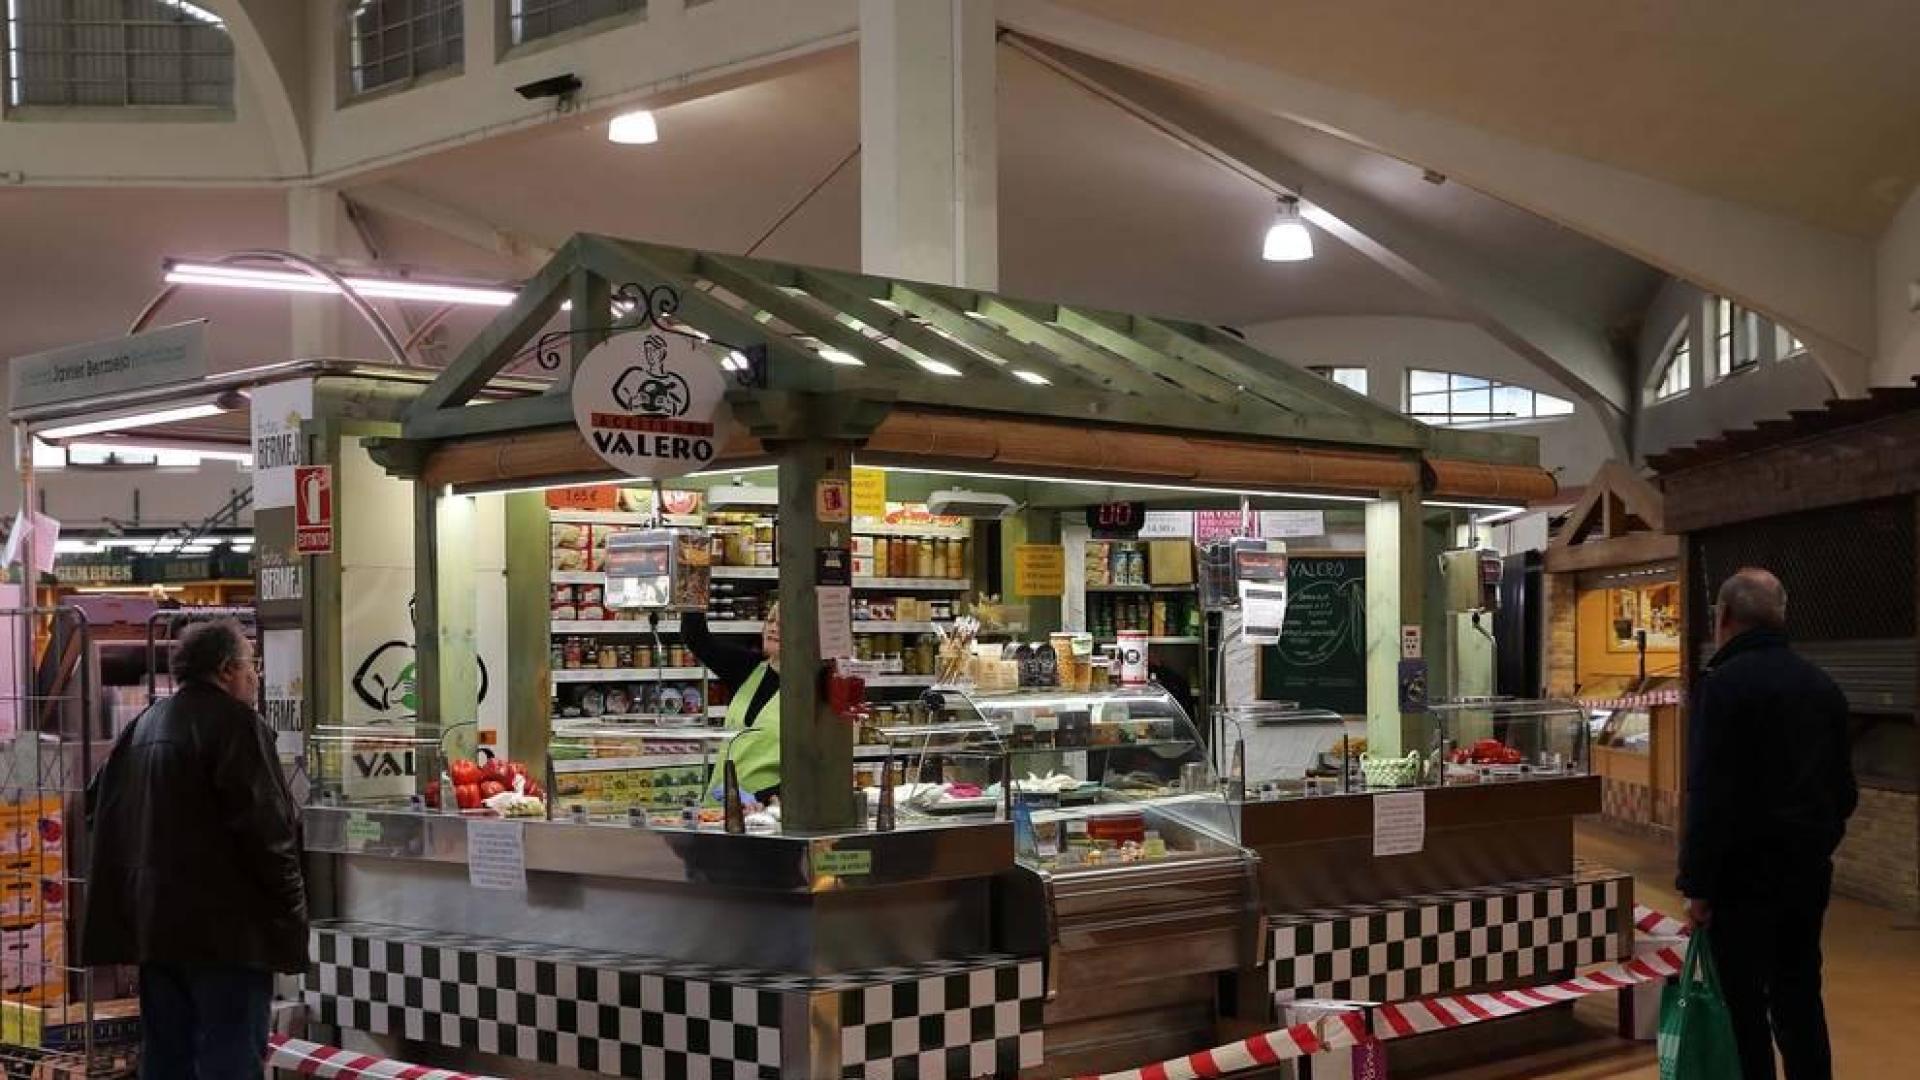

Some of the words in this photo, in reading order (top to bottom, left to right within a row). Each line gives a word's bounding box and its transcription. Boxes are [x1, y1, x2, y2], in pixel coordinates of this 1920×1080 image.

[86, 355, 130, 377] Bermejo
[593, 430, 713, 461] VALERO
[1289, 561, 1345, 577] VALERO
